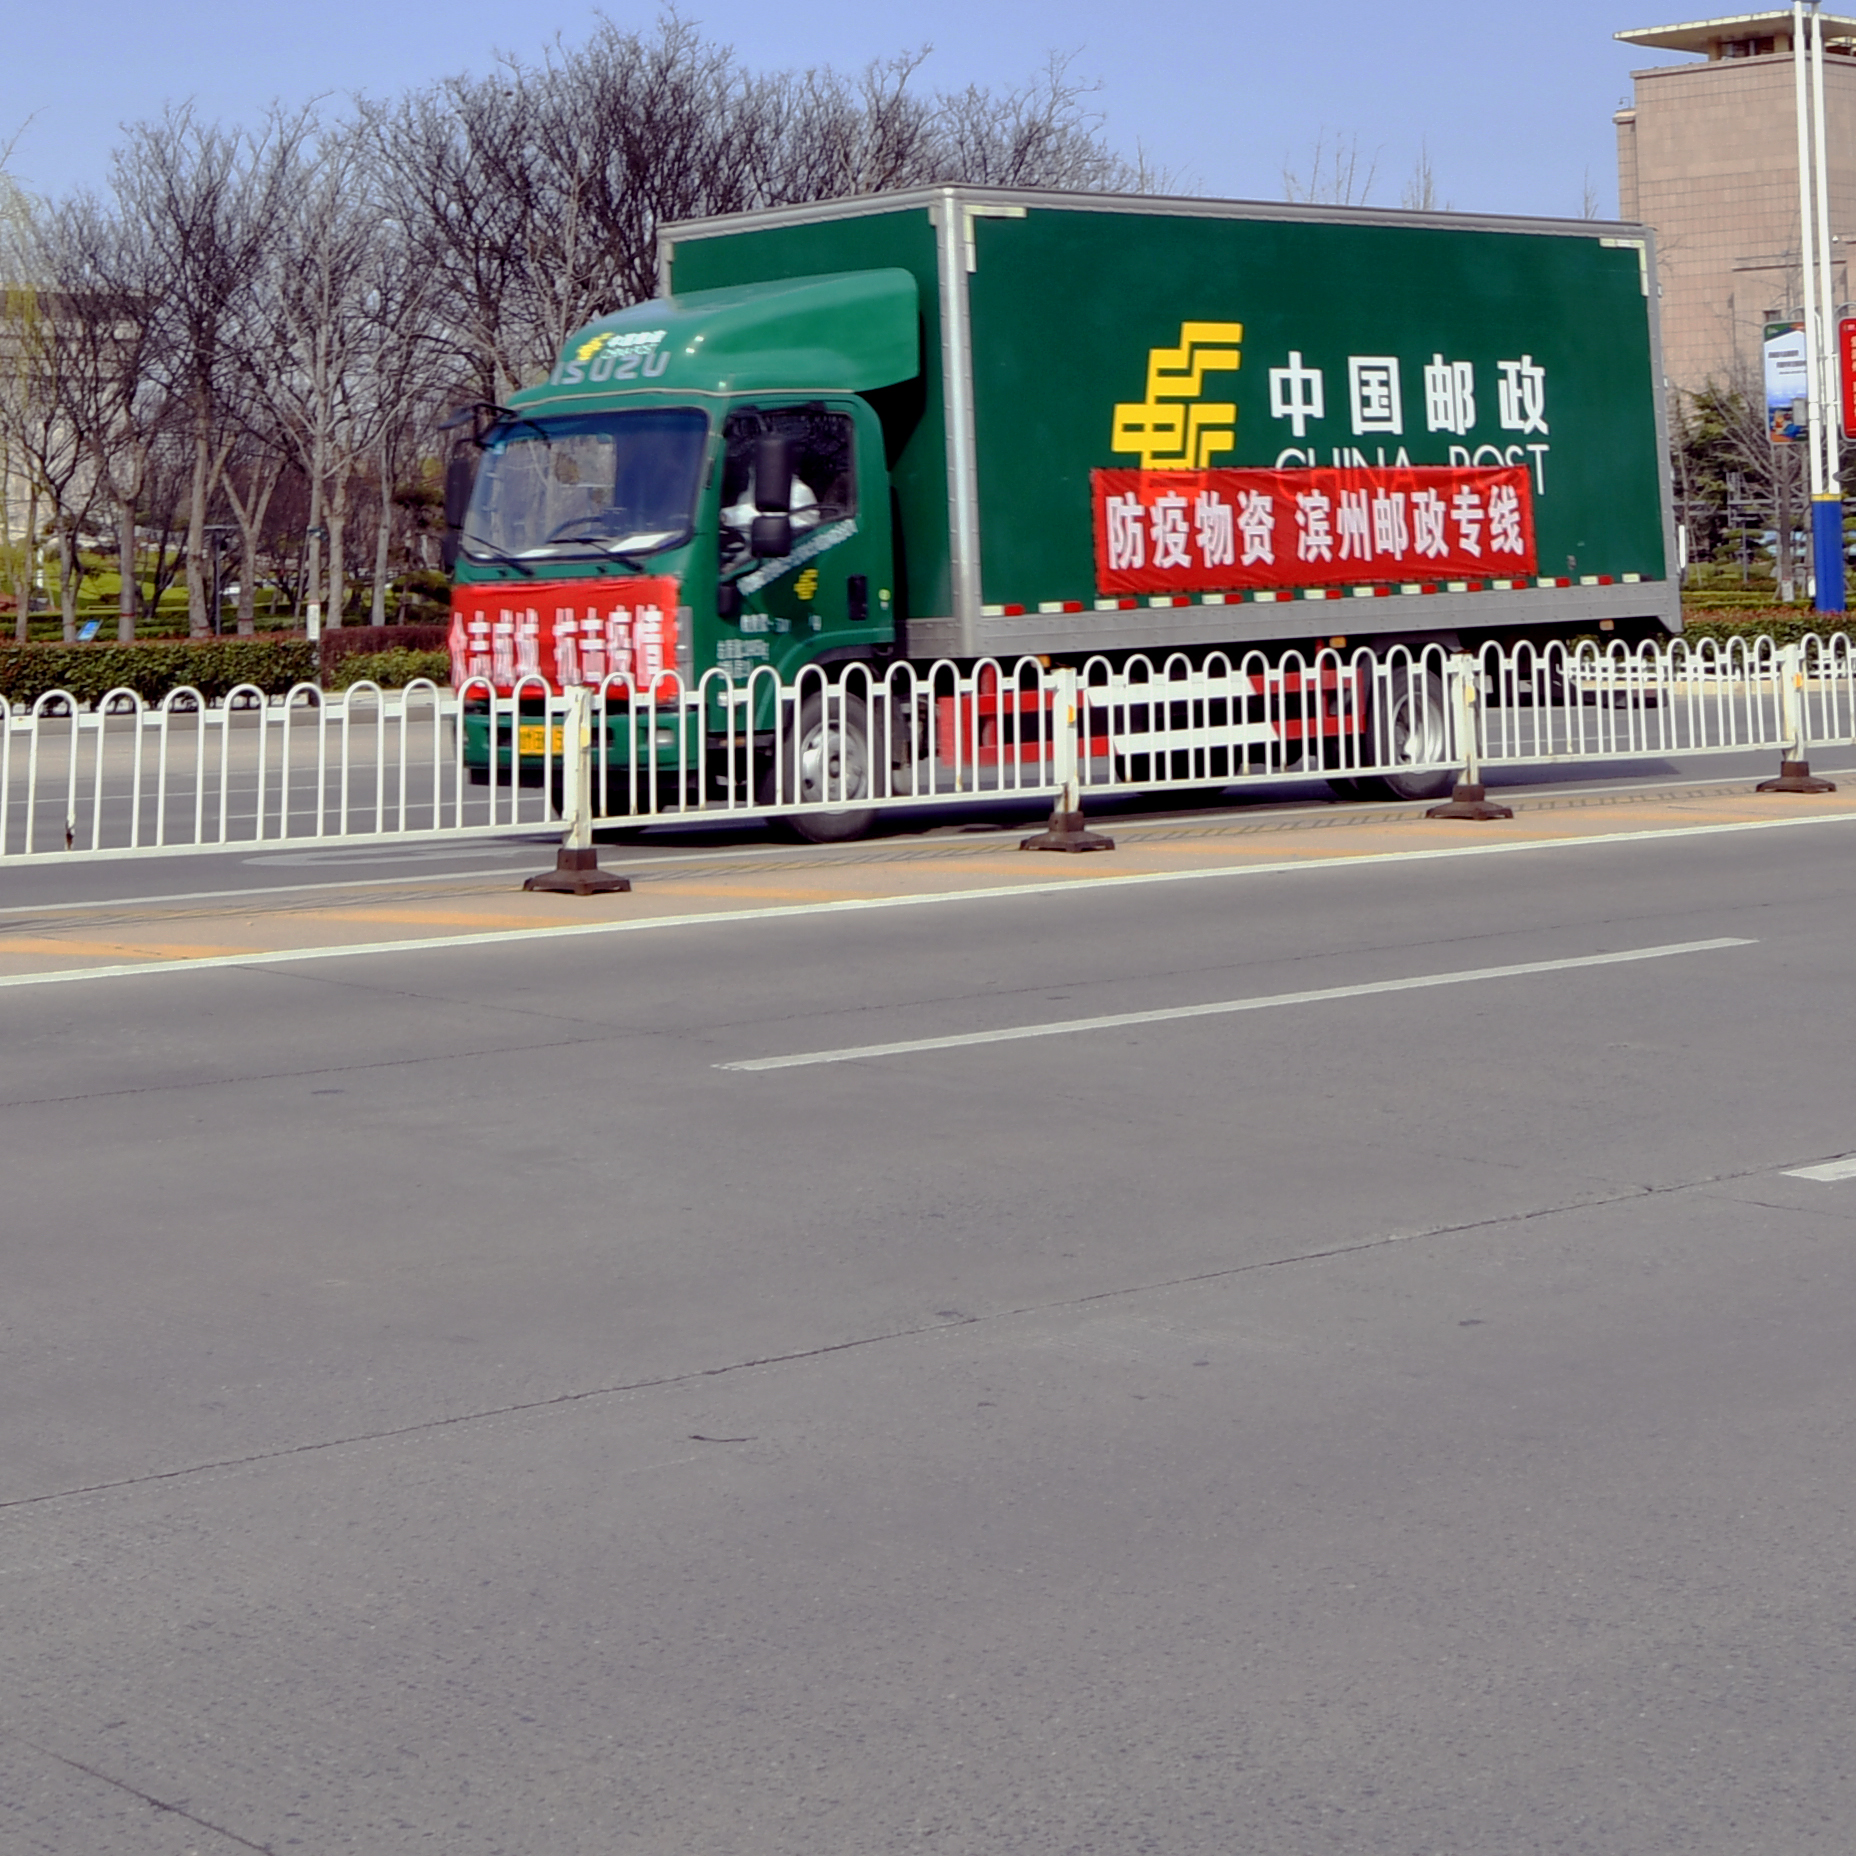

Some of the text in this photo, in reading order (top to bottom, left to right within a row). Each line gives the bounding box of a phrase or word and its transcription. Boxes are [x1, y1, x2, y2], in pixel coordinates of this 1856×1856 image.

[549, 351, 671, 386] ISUZU
[1269, 350, 1549, 437] 中国邮政
[1105, 484, 1525, 570] 防疫物资 滨州邮政专线
[551, 603, 664, 686] 抗击疫情
